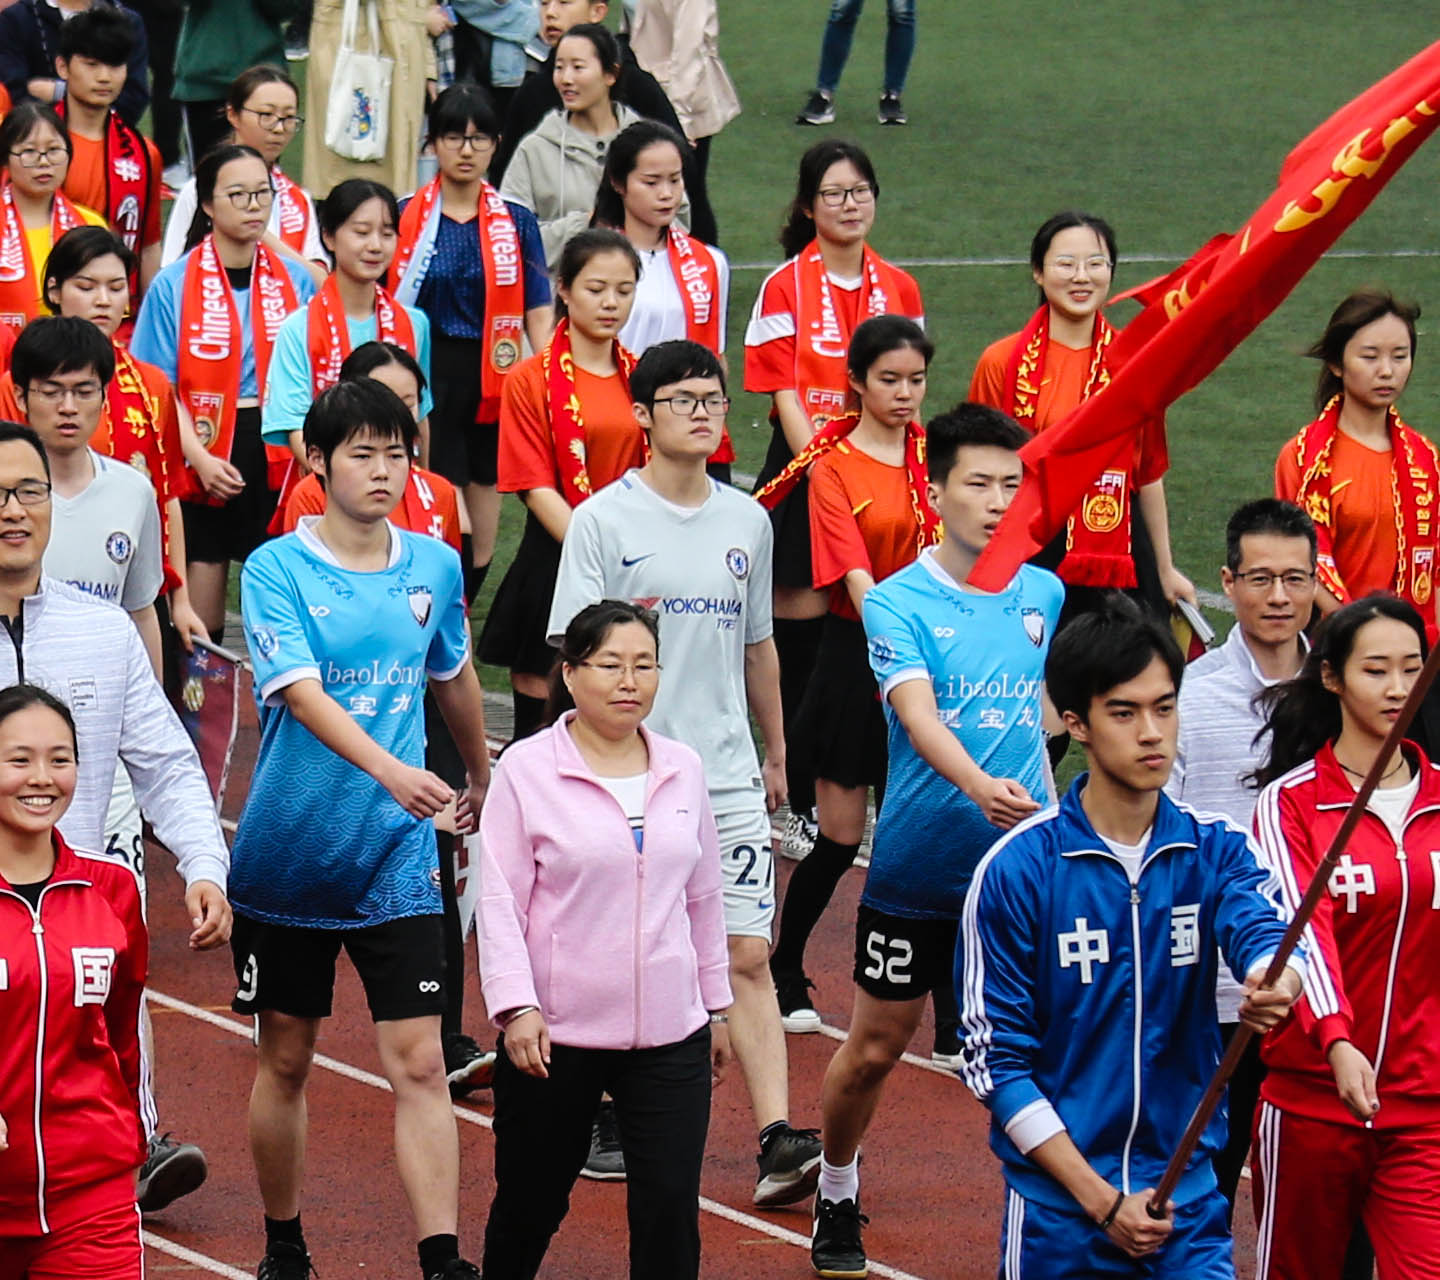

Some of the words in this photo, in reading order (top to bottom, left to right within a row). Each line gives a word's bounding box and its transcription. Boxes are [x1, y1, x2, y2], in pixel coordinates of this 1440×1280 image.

[488, 220, 518, 288] dream
[188, 275, 232, 361] Chinese
[681, 263, 712, 325] dream
[808, 392, 844, 407] CFA
[1409, 466, 1429, 537] dream
[865, 930, 912, 984] 52
[1057, 904, 1201, 984] 中国
